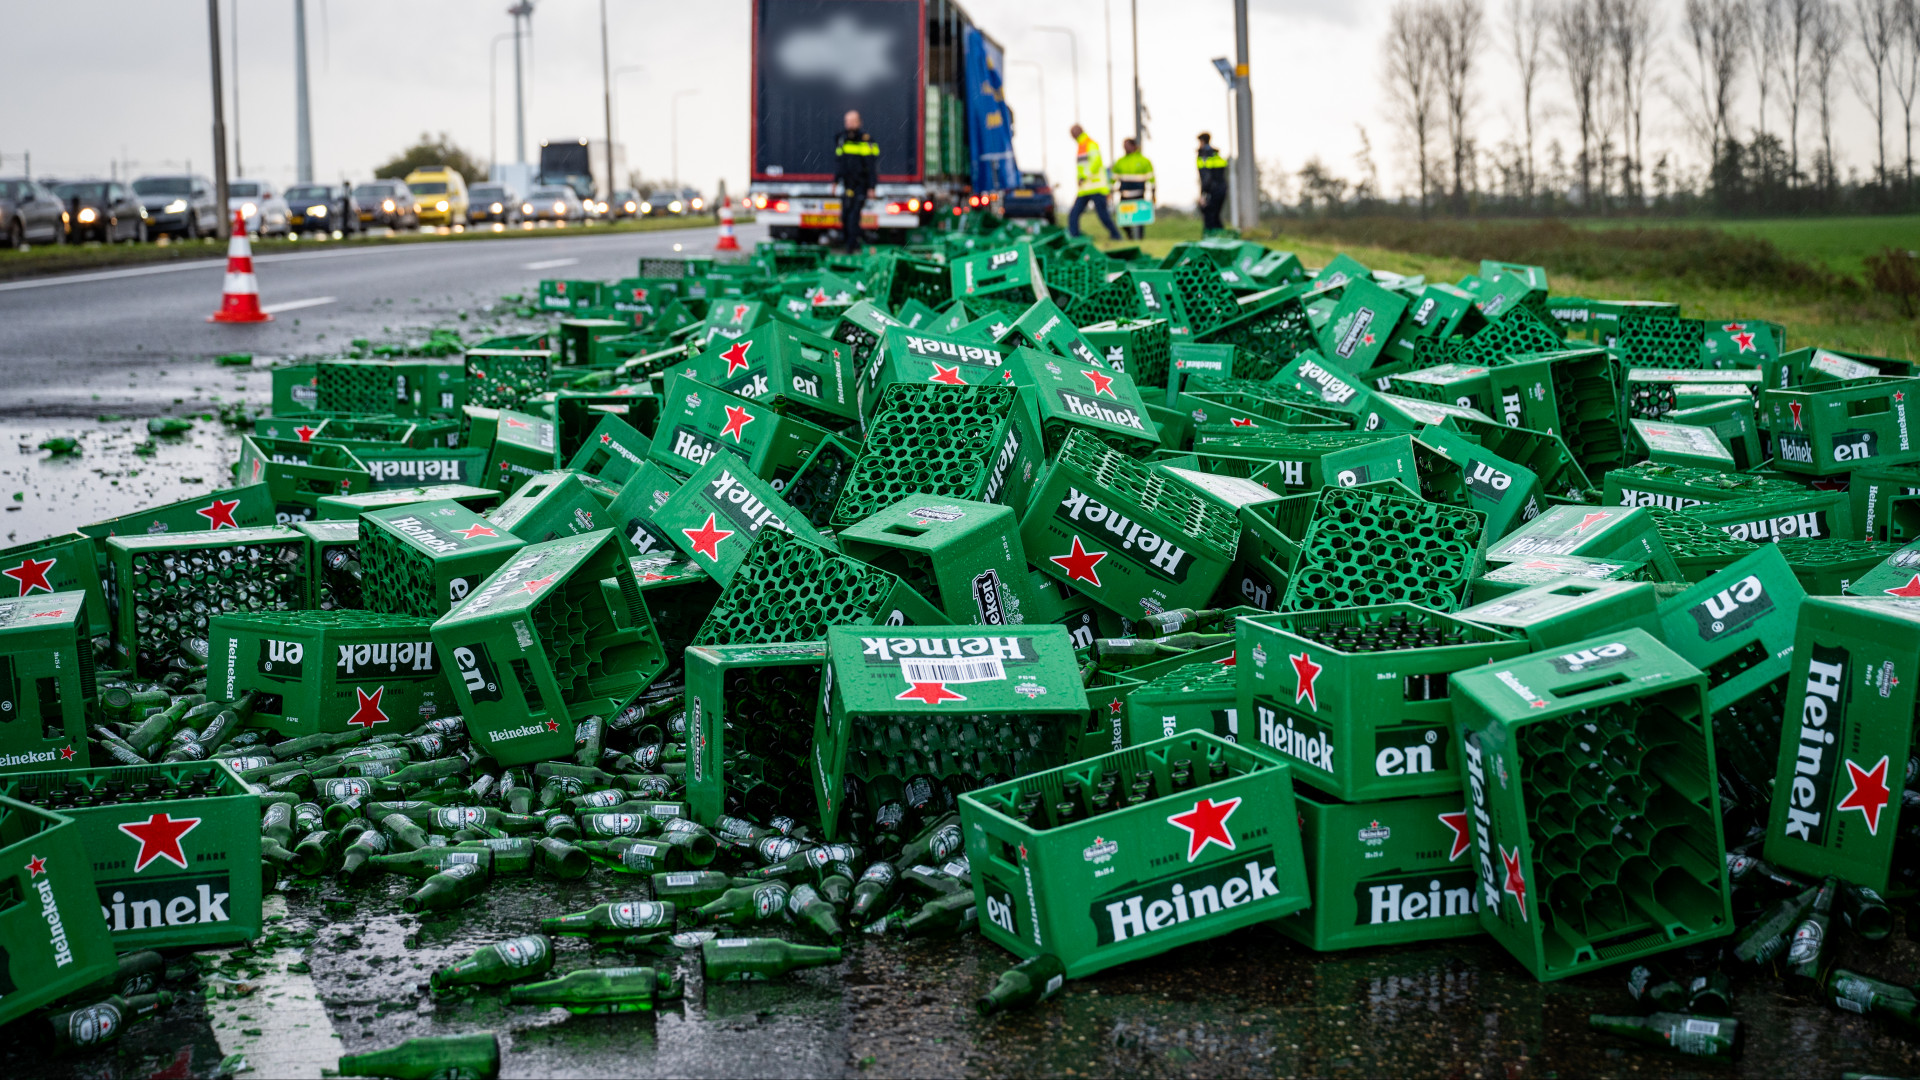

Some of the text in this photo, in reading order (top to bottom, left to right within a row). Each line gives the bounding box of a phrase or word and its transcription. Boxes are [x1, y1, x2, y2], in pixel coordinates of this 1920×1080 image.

[906, 336, 1003, 367] Heinek
[792, 364, 819, 399] en®
[834, 359, 845, 405] Heineken
[1299, 360, 1356, 404] Heinek
[1063, 393, 1145, 430] Heinek
[1897, 403, 1910, 451] Heineken
[611, 440, 645, 466] ineken
[1780, 439, 1814, 464] Heinek
[1833, 433, 1872, 463] en®
[368, 460, 460, 481] Heinek
[1465, 460, 1512, 490] en®
[1722, 512, 1821, 544] Heine
[1866, 485, 1879, 534] Heineken
[391, 516, 457, 553] Heinek
[1061, 487, 1186, 576] Heinek
[459, 555, 543, 616] Heinek
[1241, 577, 1272, 610] en®
[1701, 575, 1762, 633] en®
[226, 637, 238, 700] Heineken
[267, 639, 304, 672] en®
[337, 641, 434, 674] Heinek
[861, 637, 1025, 661] Heinek
[1561, 642, 1628, 672] en®
[453, 646, 498, 695] en®
[488, 723, 545, 743] Heineken
[1258, 706, 1334, 773] Heinek
[1375, 730, 1436, 776] en®
[1785, 658, 1843, 842] Heinek
[0, 749, 56, 768] eineken
[1150, 827, 1268, 868] TRADE MARK
[1464, 741, 1500, 916] Heinek
[94, 852, 226, 871] TRADE MARK
[1416, 850, 1442, 860] TRADE
[100, 884, 230, 931] inek
[987, 892, 1016, 934] en®
[1022, 865, 1042, 947] Heineken
[1106, 861, 1280, 942] Heinek
[1369, 880, 1479, 924] Hein
[38, 879, 73, 969] Heineken
